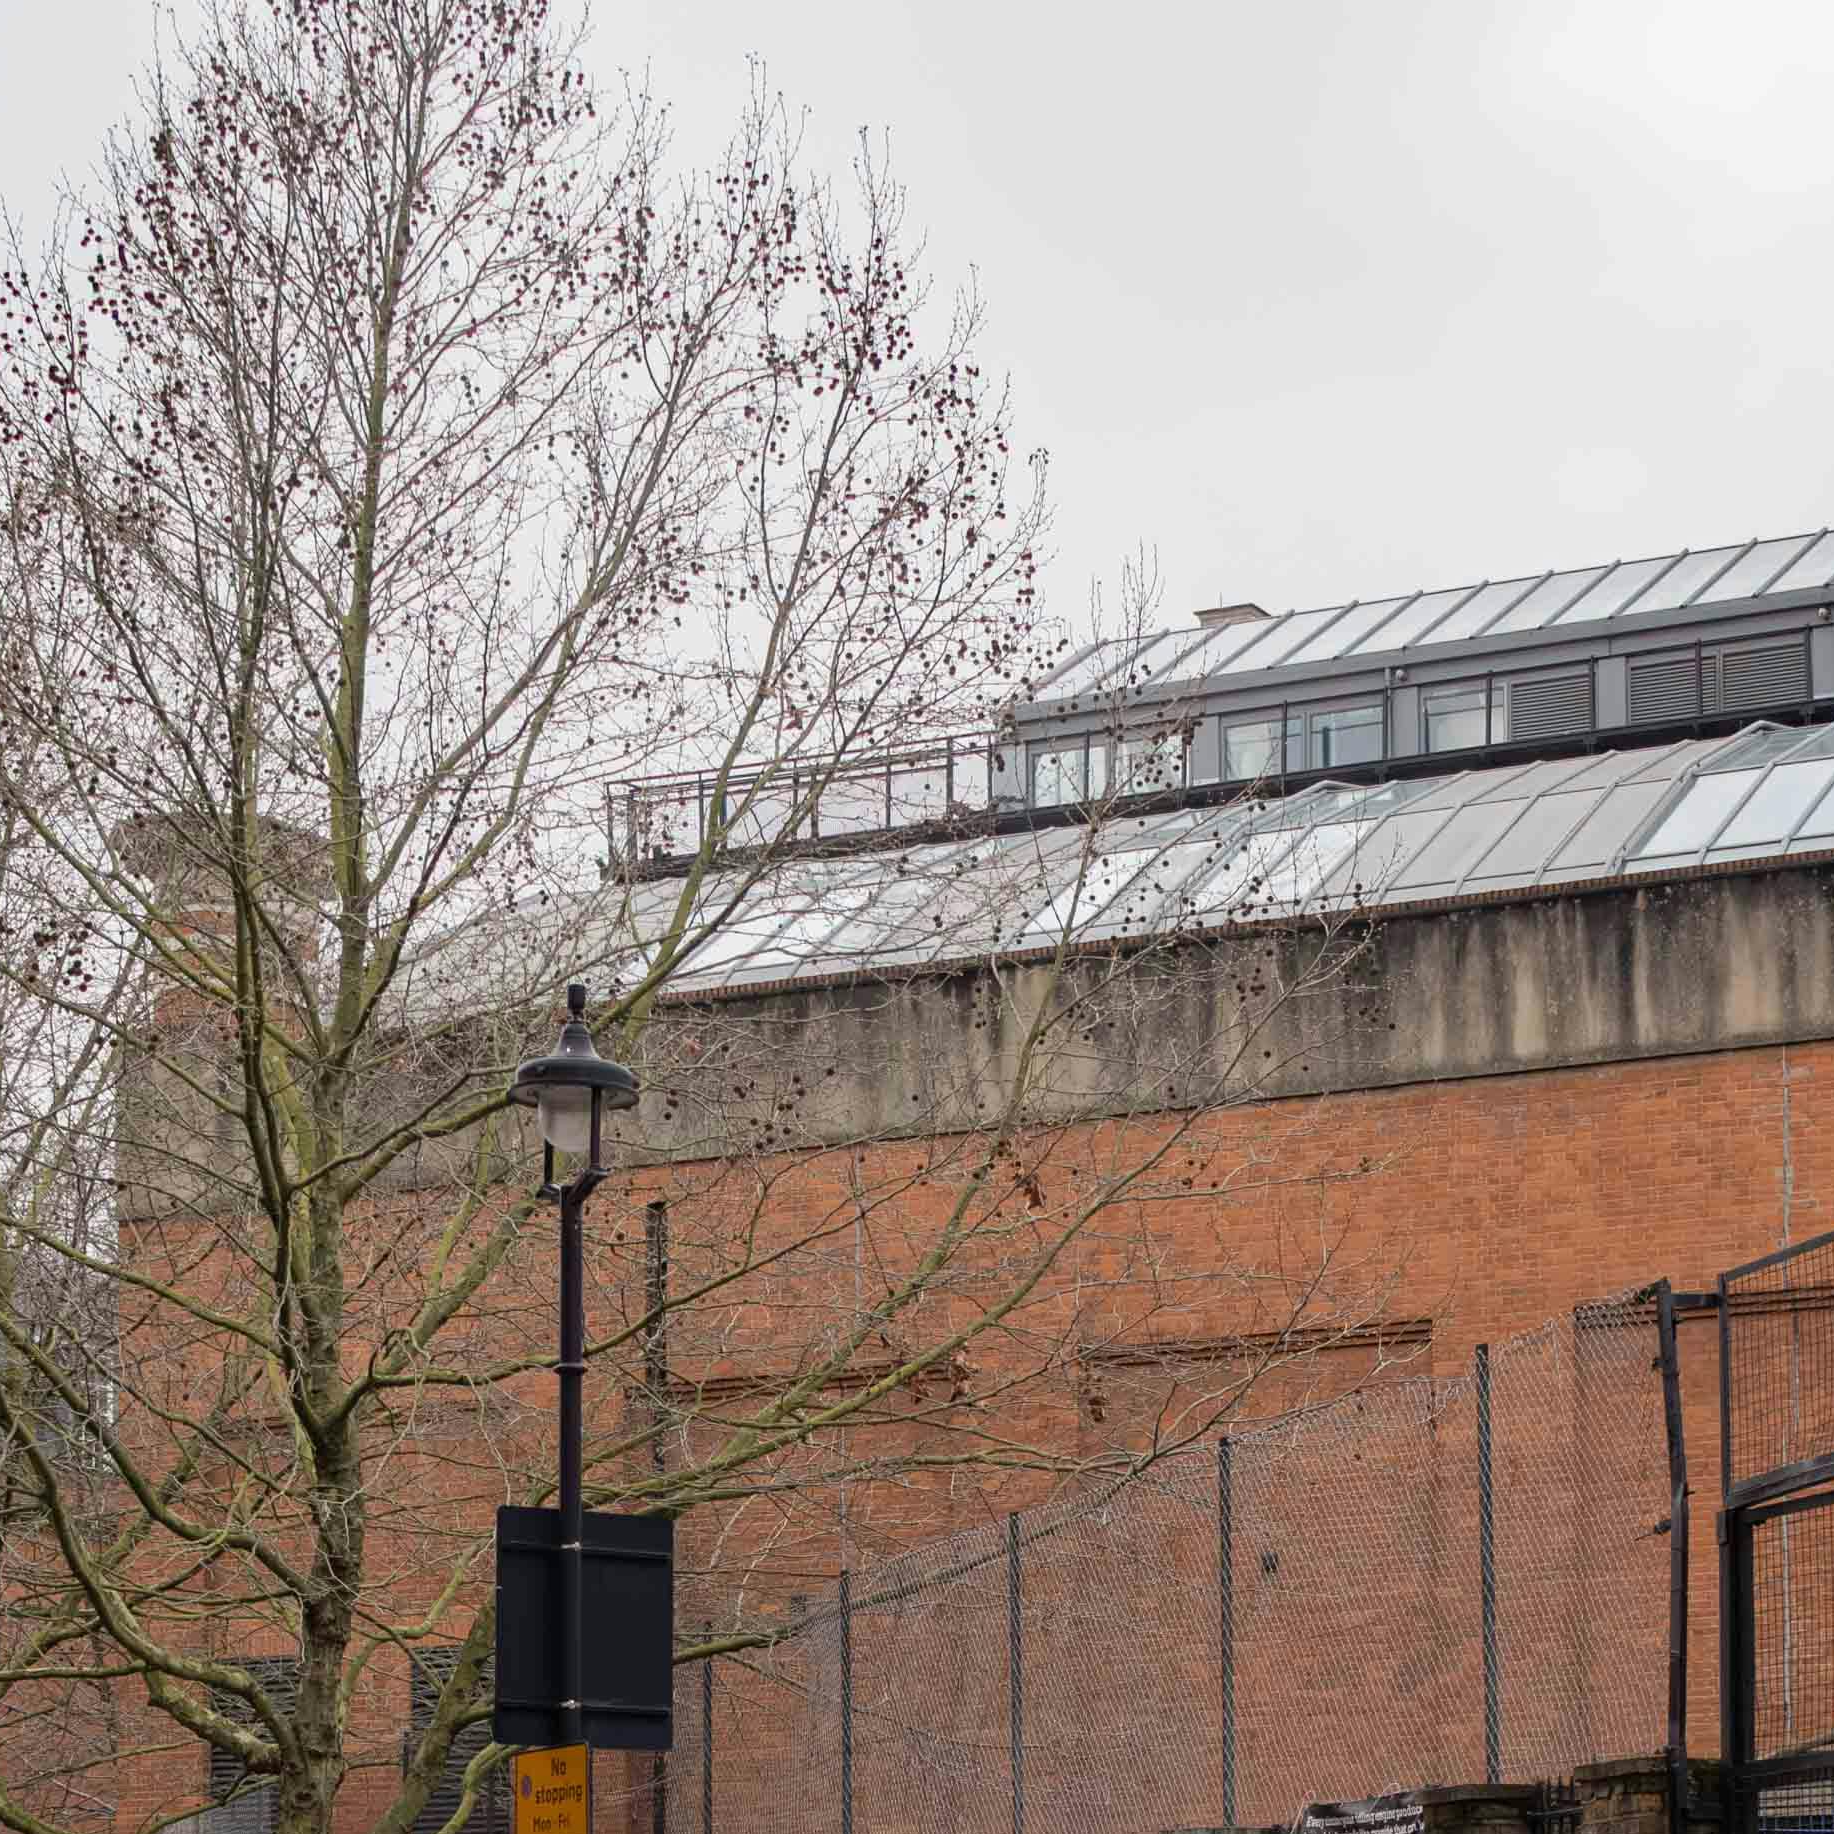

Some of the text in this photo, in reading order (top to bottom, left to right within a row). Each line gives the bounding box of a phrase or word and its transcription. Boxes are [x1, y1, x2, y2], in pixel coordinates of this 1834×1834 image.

[550, 1756, 567, 1776] No
[534, 1784, 583, 1807] stopping
[532, 1816, 552, 1833] Mon
